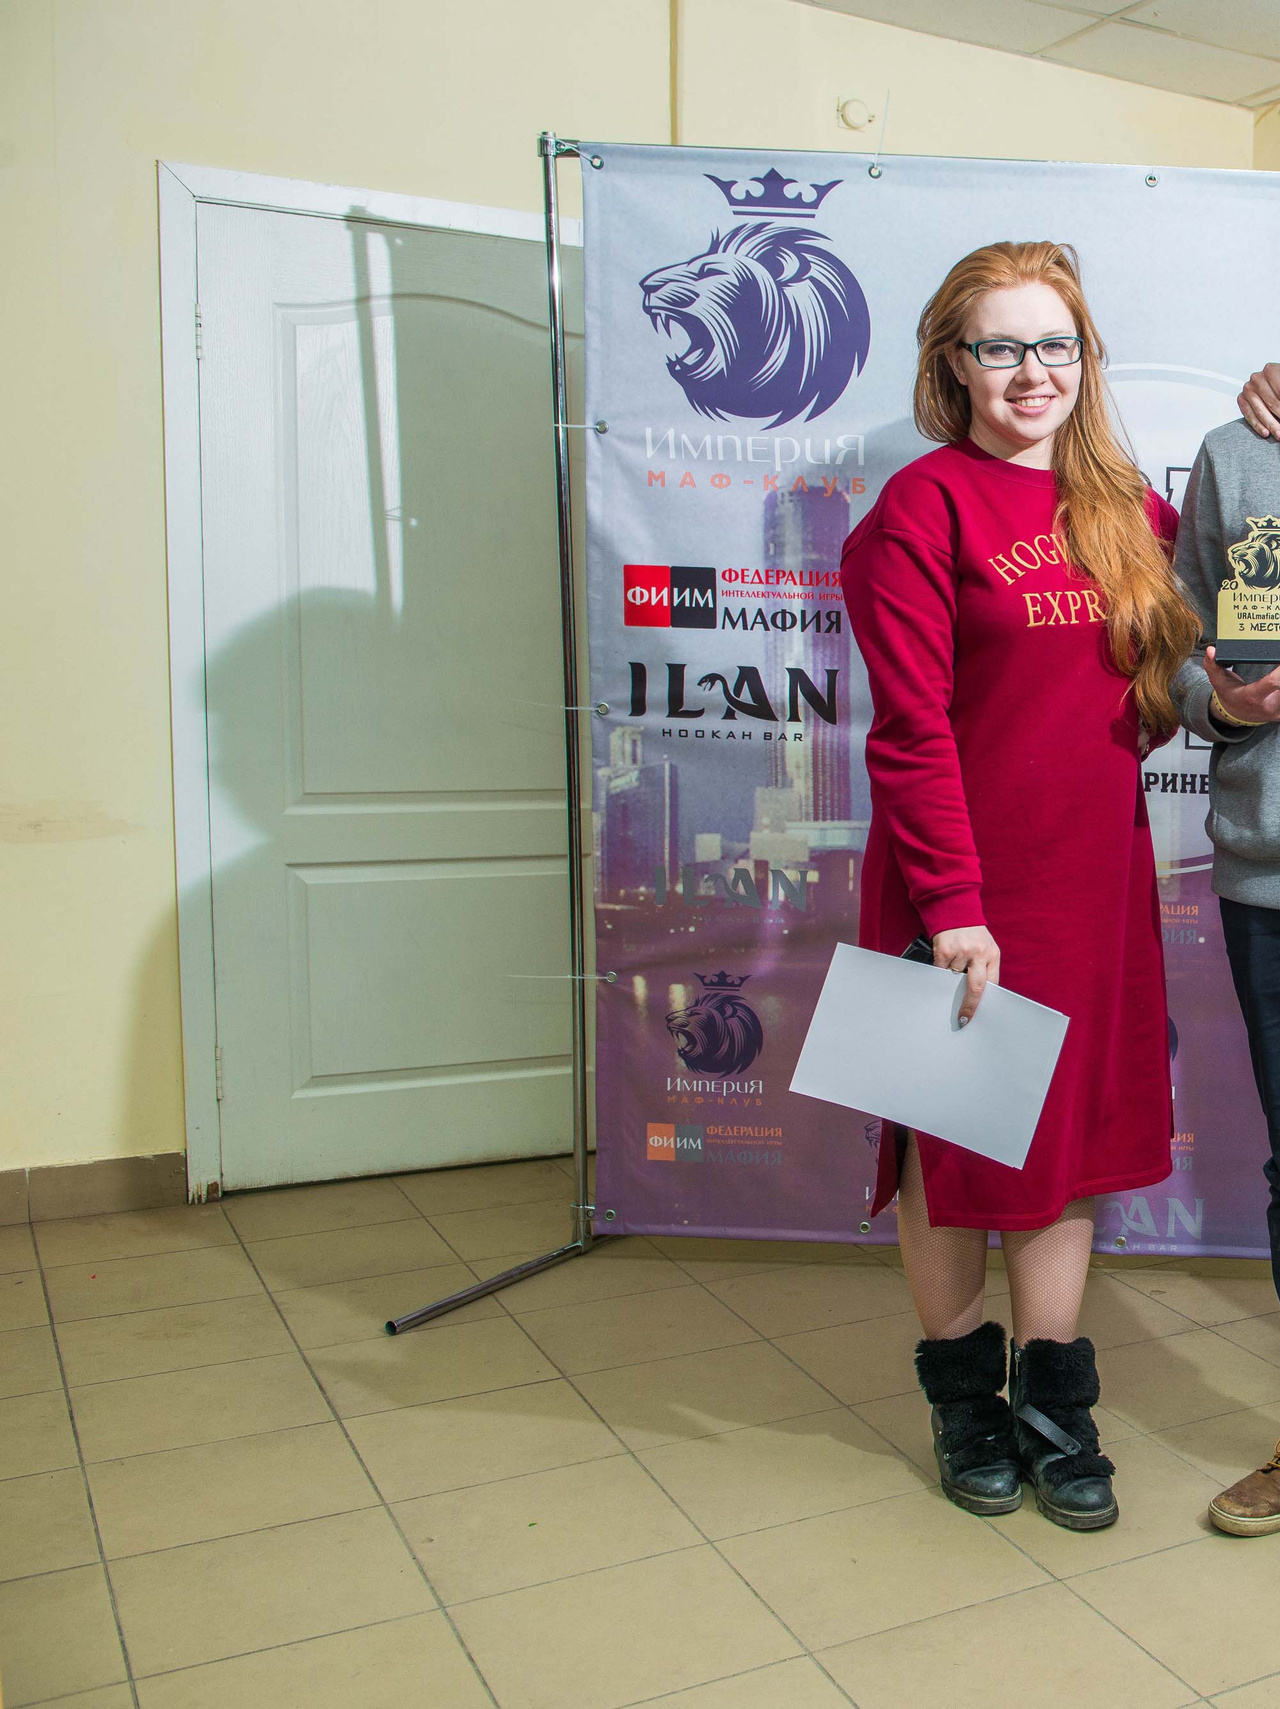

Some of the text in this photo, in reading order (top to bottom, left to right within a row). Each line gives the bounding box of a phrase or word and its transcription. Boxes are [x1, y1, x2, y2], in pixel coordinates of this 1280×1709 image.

[647, 470, 867, 497] МАФ-КЛУБ
[721, 567, 842, 589] ФЕДЕРАЦИЯ
[1221, 581, 1239, 591] 20
[626, 586, 714, 609] ФИИМ
[721, 589, 844, 602] ИНТЕЛЛЕКТУАЛЬНОЙ ИГРЫ
[721, 606, 842, 635] МАФИЯ
[1238, 623, 1245, 632] 3
[628, 661, 840, 726] ILAN
[662, 728, 804, 742] HOOKAH BAR
[655, 864, 809, 912] ILAN
[666, 1095, 764, 1107] МАФ-КЛУБ
[706, 1125, 783, 1138] ФЕДЕРАЦИЯ
[649, 1135, 703, 1150] ФИИМ
[706, 1149, 783, 1165] МАФИЯ
[1148, 1243, 1178, 1253] BAR
